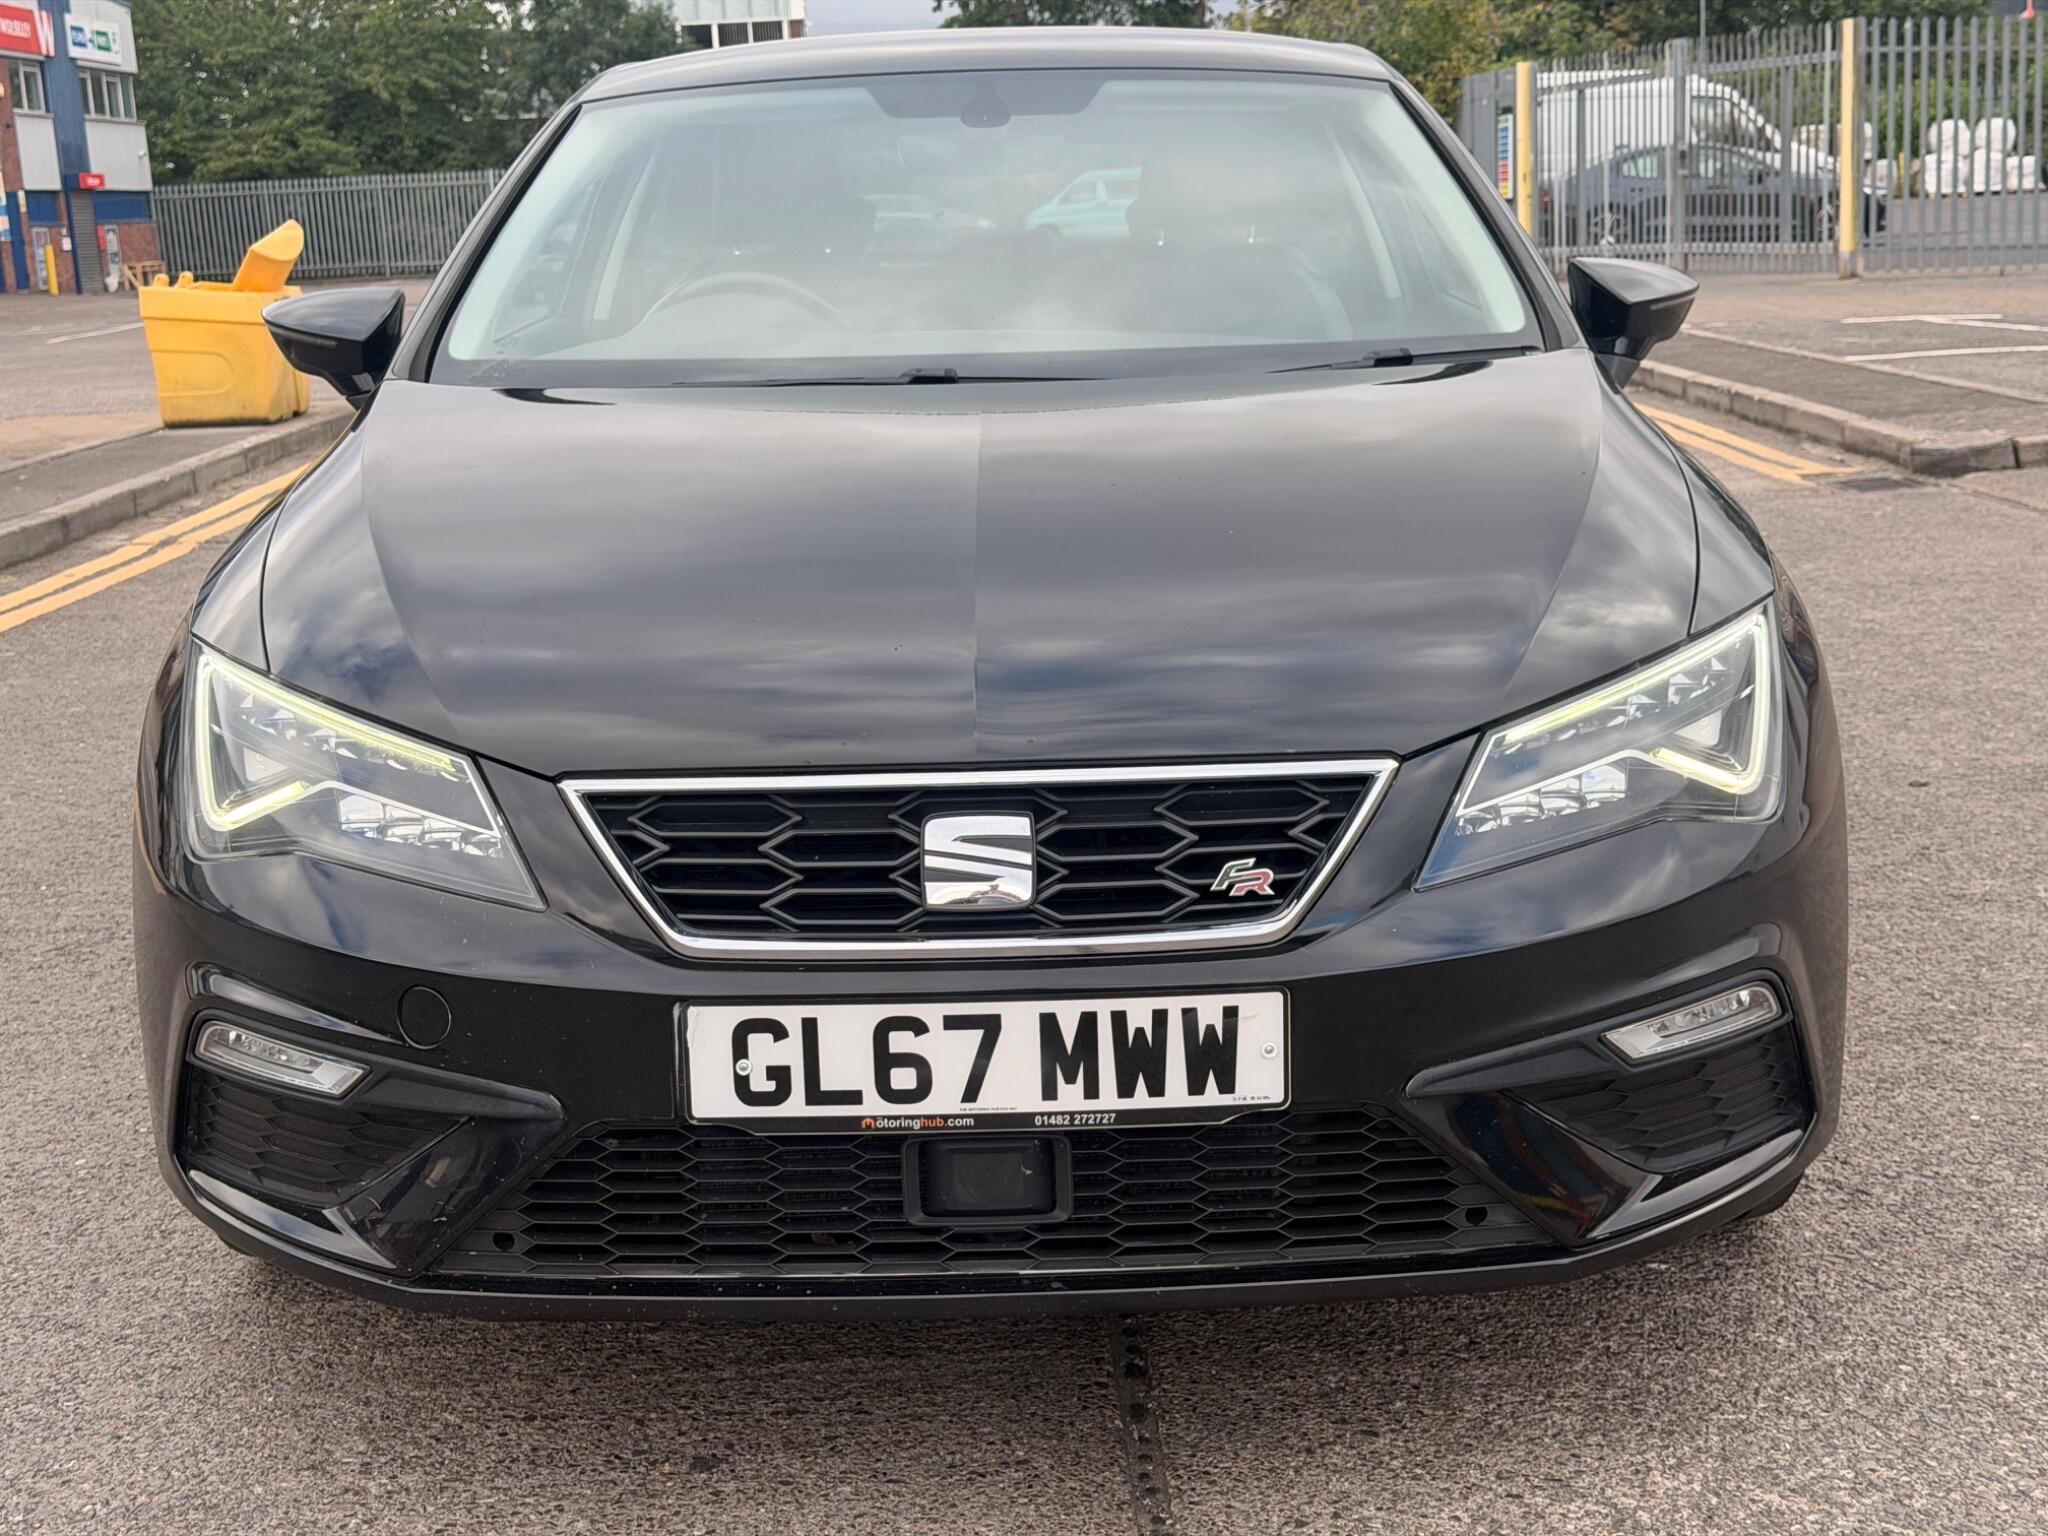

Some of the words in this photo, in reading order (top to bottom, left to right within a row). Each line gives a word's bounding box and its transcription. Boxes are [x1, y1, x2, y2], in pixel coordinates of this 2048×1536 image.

[1210, 857, 1275, 896] FR
[732, 1013, 1003, 1107] GL67
[1039, 1005, 1239, 1101] MWW
[1034, 1114, 1071, 1126] 01482
[1073, 1113, 1116, 1125] 272727
